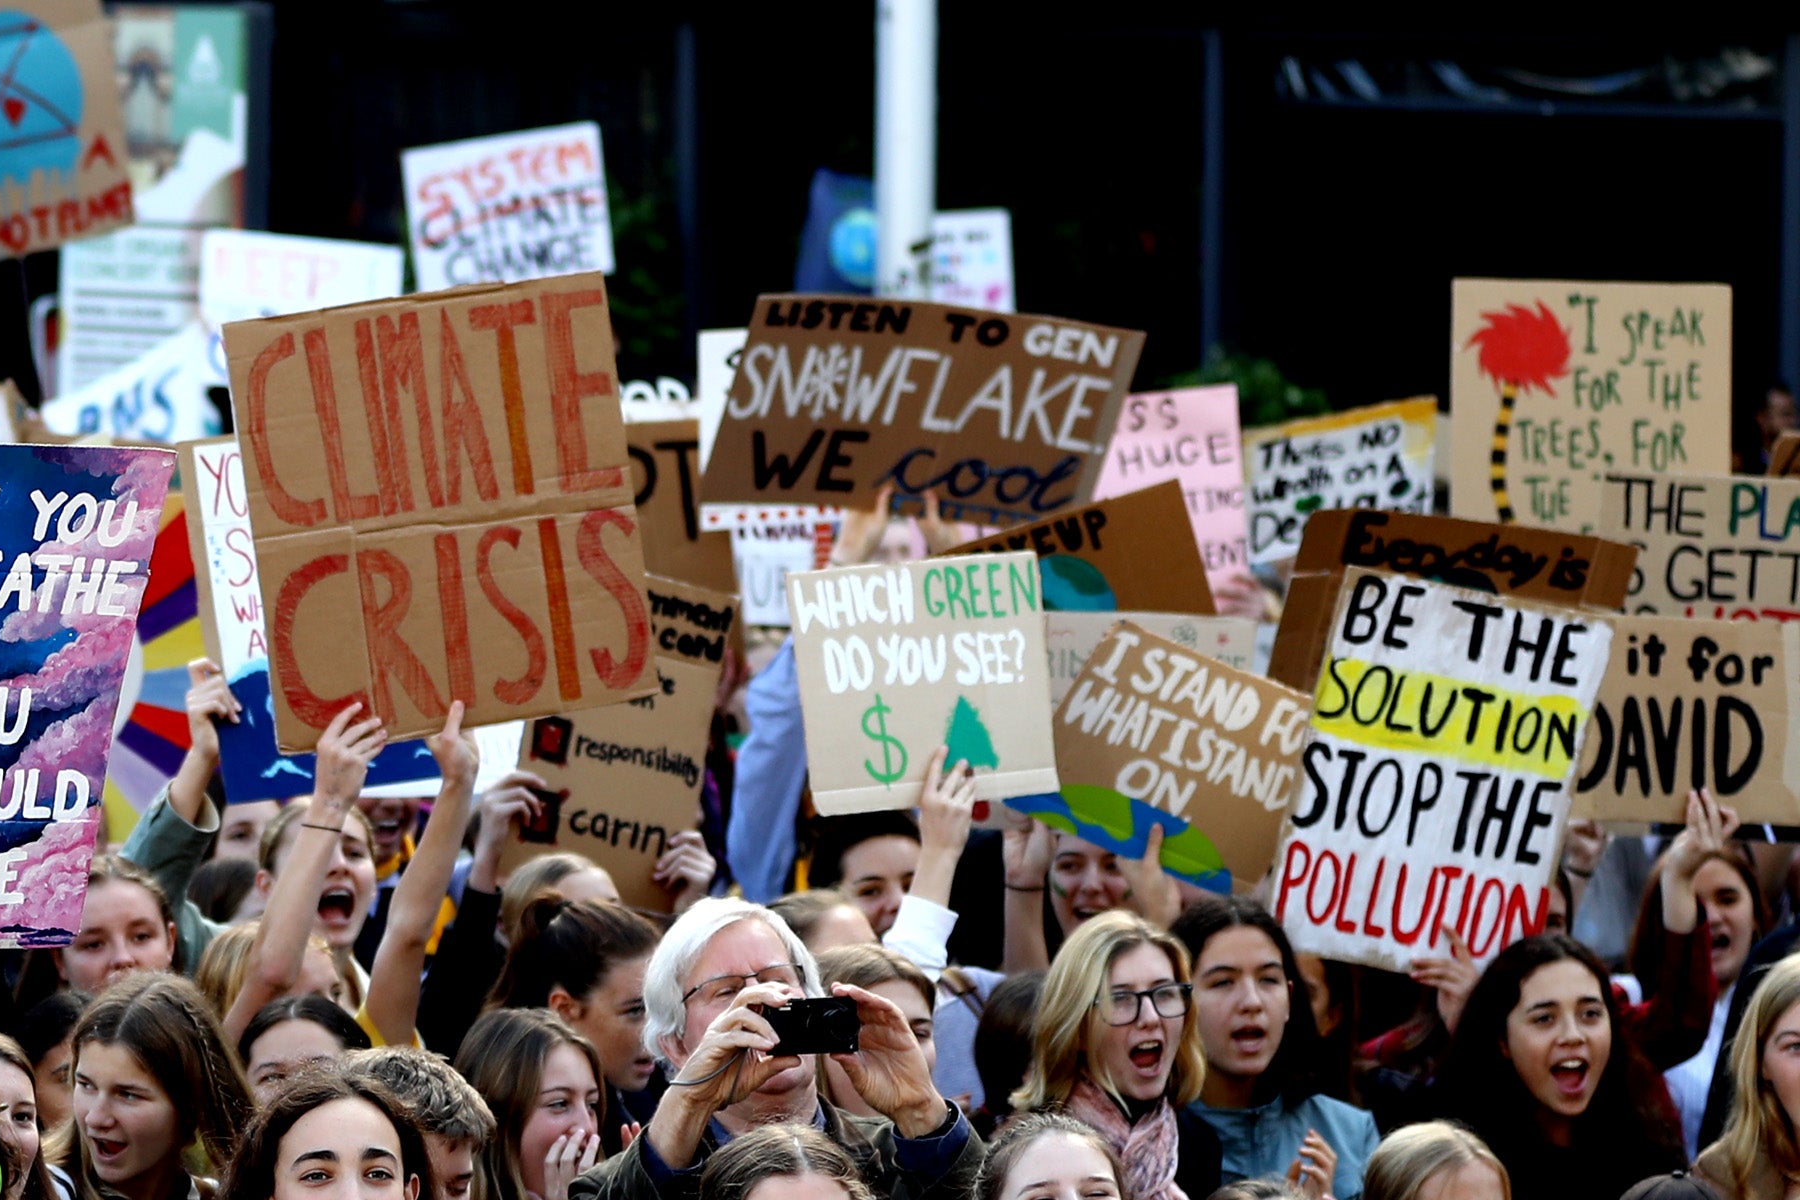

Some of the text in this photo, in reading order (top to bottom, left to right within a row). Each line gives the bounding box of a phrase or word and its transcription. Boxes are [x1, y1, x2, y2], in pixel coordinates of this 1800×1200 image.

[417, 140, 593, 222] SYSTEM
[765, 301, 1121, 369] LISTEN TO GEN
[1618, 306, 1705, 365] SPEAK
[248, 290, 623, 527] CLIMATE
[1573, 359, 1702, 412] FOR THE
[753, 429, 872, 493] WE
[1117, 431, 1234, 478] HUGE
[1632, 419, 1686, 473] FOR
[30, 490, 138, 548] YOU
[1605, 474, 1707, 538] THE
[792, 560, 1037, 633] WHICH GREEN
[1549, 547, 1589, 591] is
[274, 509, 649, 731] CRISIS
[1343, 575, 1588, 686] BE THE
[823, 635, 875, 693] DO
[878, 633, 946, 686] YOU
[952, 629, 1026, 685] SEE?
[1093, 632, 1139, 685] I
[1131, 648, 1261, 731] STAND
[1628, 634, 1774, 687] it for
[1317, 658, 1578, 762] SOLUTION
[575, 734, 701, 788] responsibility
[1064, 681, 1296, 811] WHAT I STAND
[1577, 695, 1764, 797] DAVID
[570, 808, 669, 858] carin
[1292, 743, 1563, 865] STOP THE
[1276, 840, 1550, 958] POLLUTION
